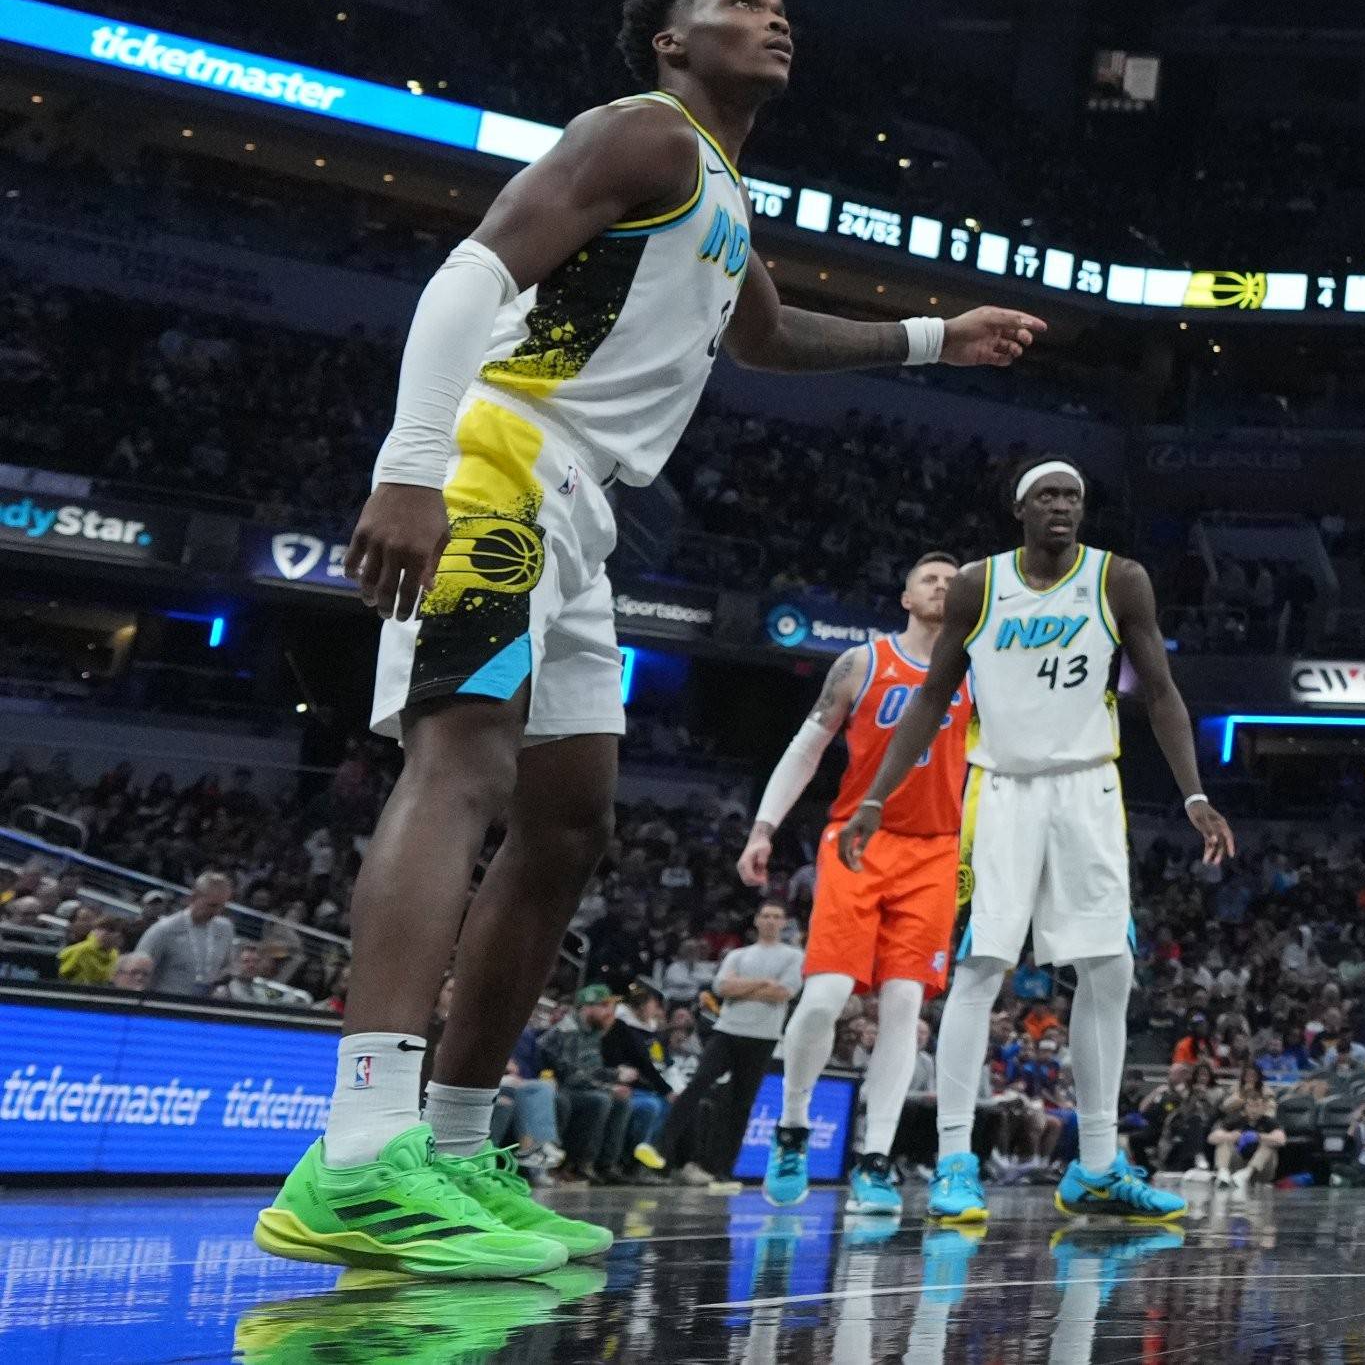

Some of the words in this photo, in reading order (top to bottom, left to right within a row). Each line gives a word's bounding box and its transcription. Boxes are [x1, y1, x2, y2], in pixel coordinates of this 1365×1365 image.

[89, 25, 346, 111] ticketmaster
[1013, 253, 1040, 279] 17
[995, 614, 1089, 651] INDY
[1037, 654, 1089, 690] 43
[0, 1064, 211, 1126] ticketmaster
